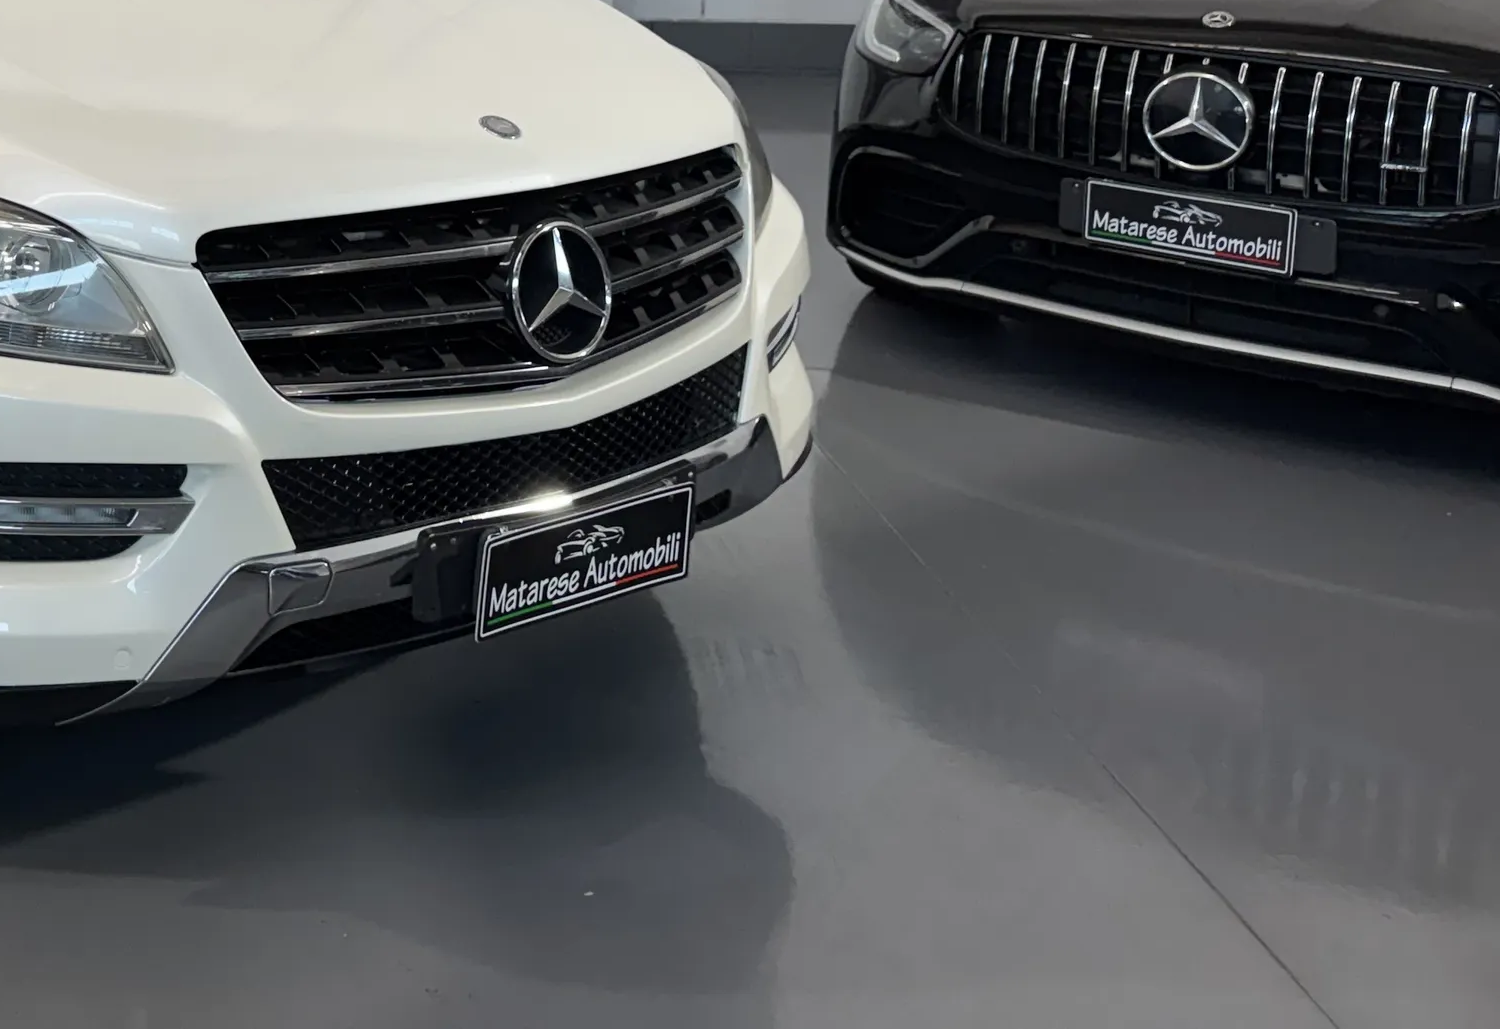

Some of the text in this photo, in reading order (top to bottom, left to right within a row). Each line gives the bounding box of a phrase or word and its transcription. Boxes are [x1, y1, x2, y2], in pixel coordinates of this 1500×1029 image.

[1092, 209, 1282, 261] Matarese Automobili
[489, 531, 681, 618] Matarese Automobili
